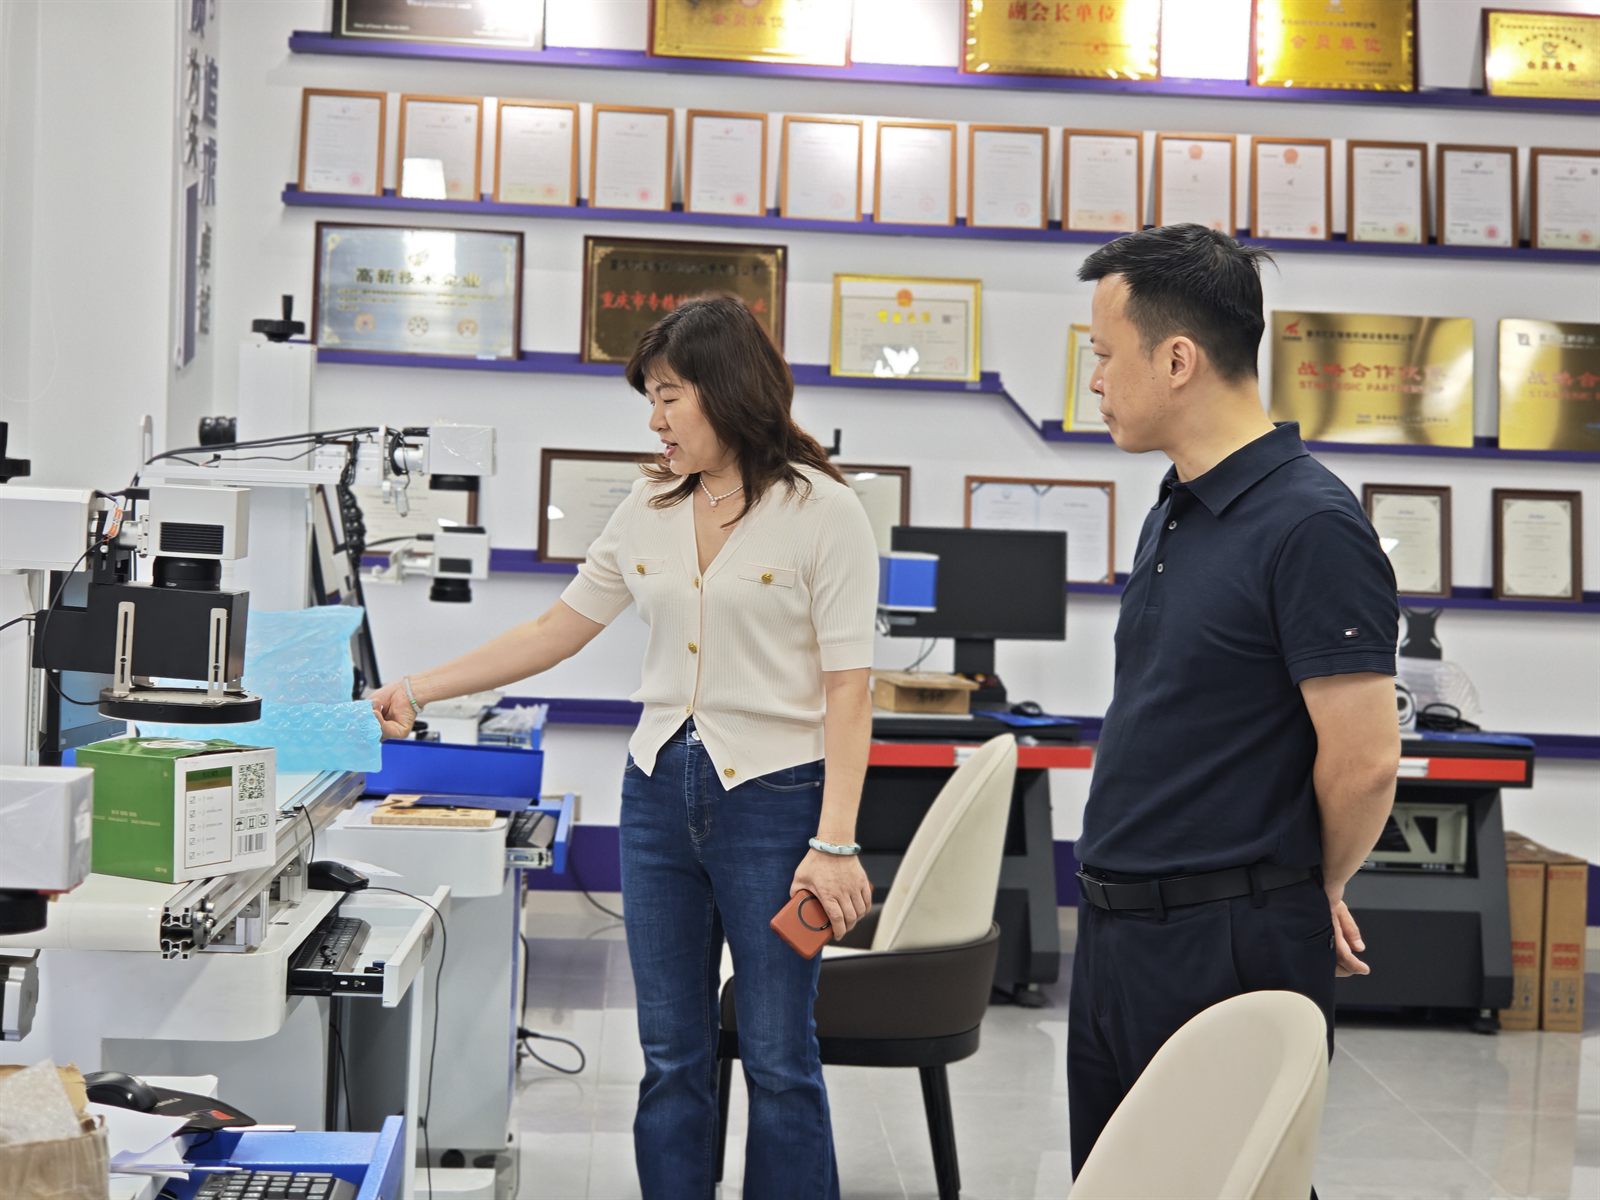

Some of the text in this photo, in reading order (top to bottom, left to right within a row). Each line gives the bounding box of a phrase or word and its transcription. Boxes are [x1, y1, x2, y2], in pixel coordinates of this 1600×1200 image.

[1008, 1, 1116, 22] 副会长单位
[356, 267, 480, 288] 高新技术企业
